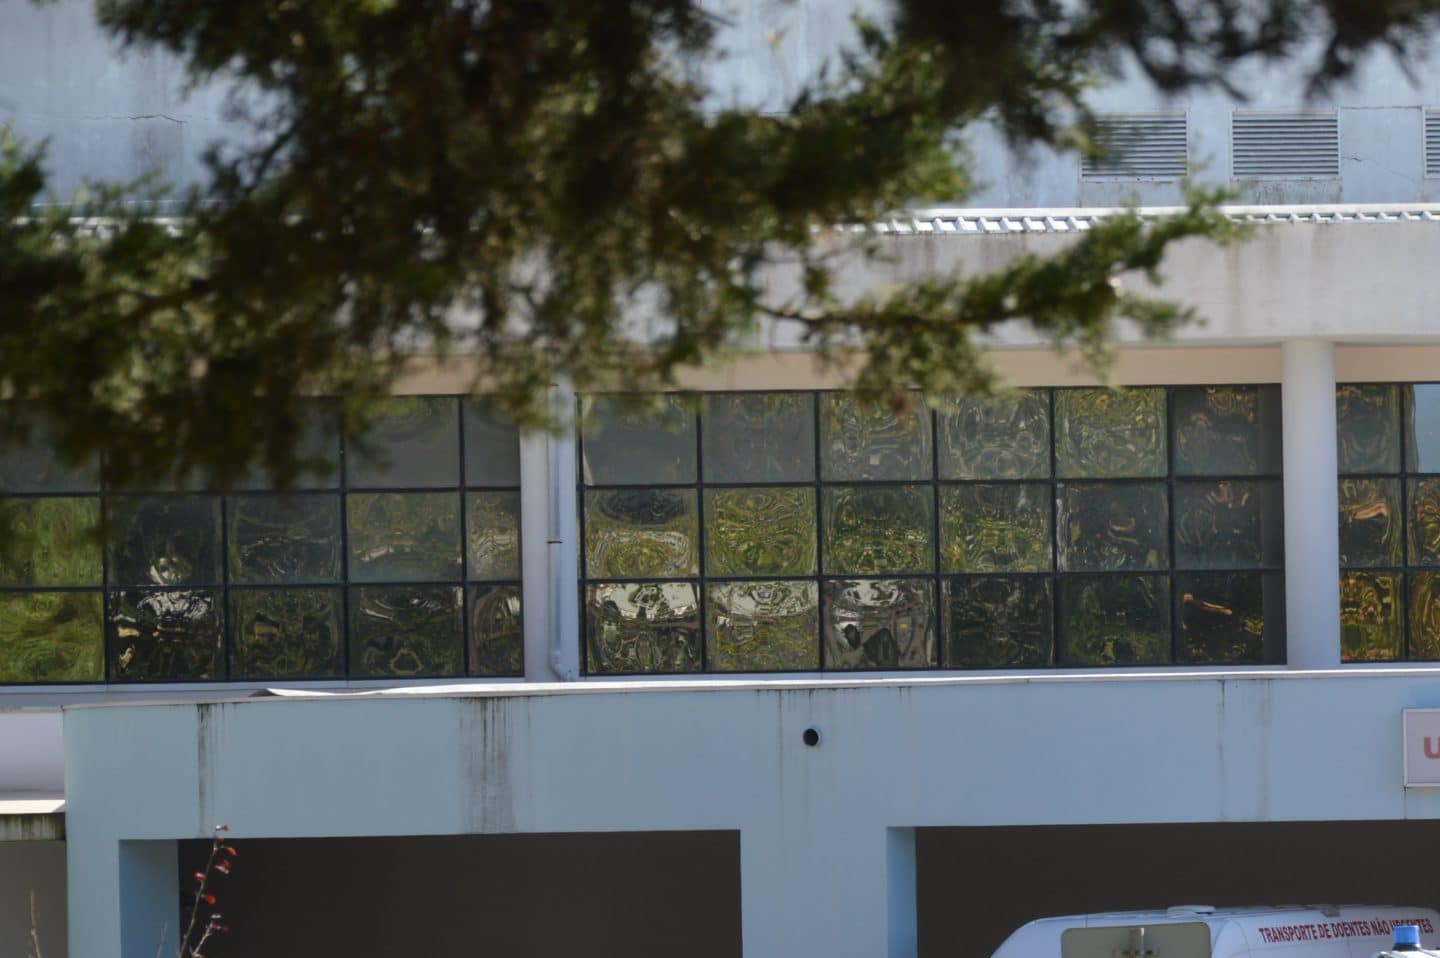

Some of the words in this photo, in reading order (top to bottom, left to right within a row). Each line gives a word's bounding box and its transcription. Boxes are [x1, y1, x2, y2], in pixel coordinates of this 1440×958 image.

[1258, 924, 1318, 943] TRANSPORTE
[1319, 923, 1331, 939] DE
[1333, 921, 1371, 938] DOENTES
[1371, 917, 1390, 936] NÃO
